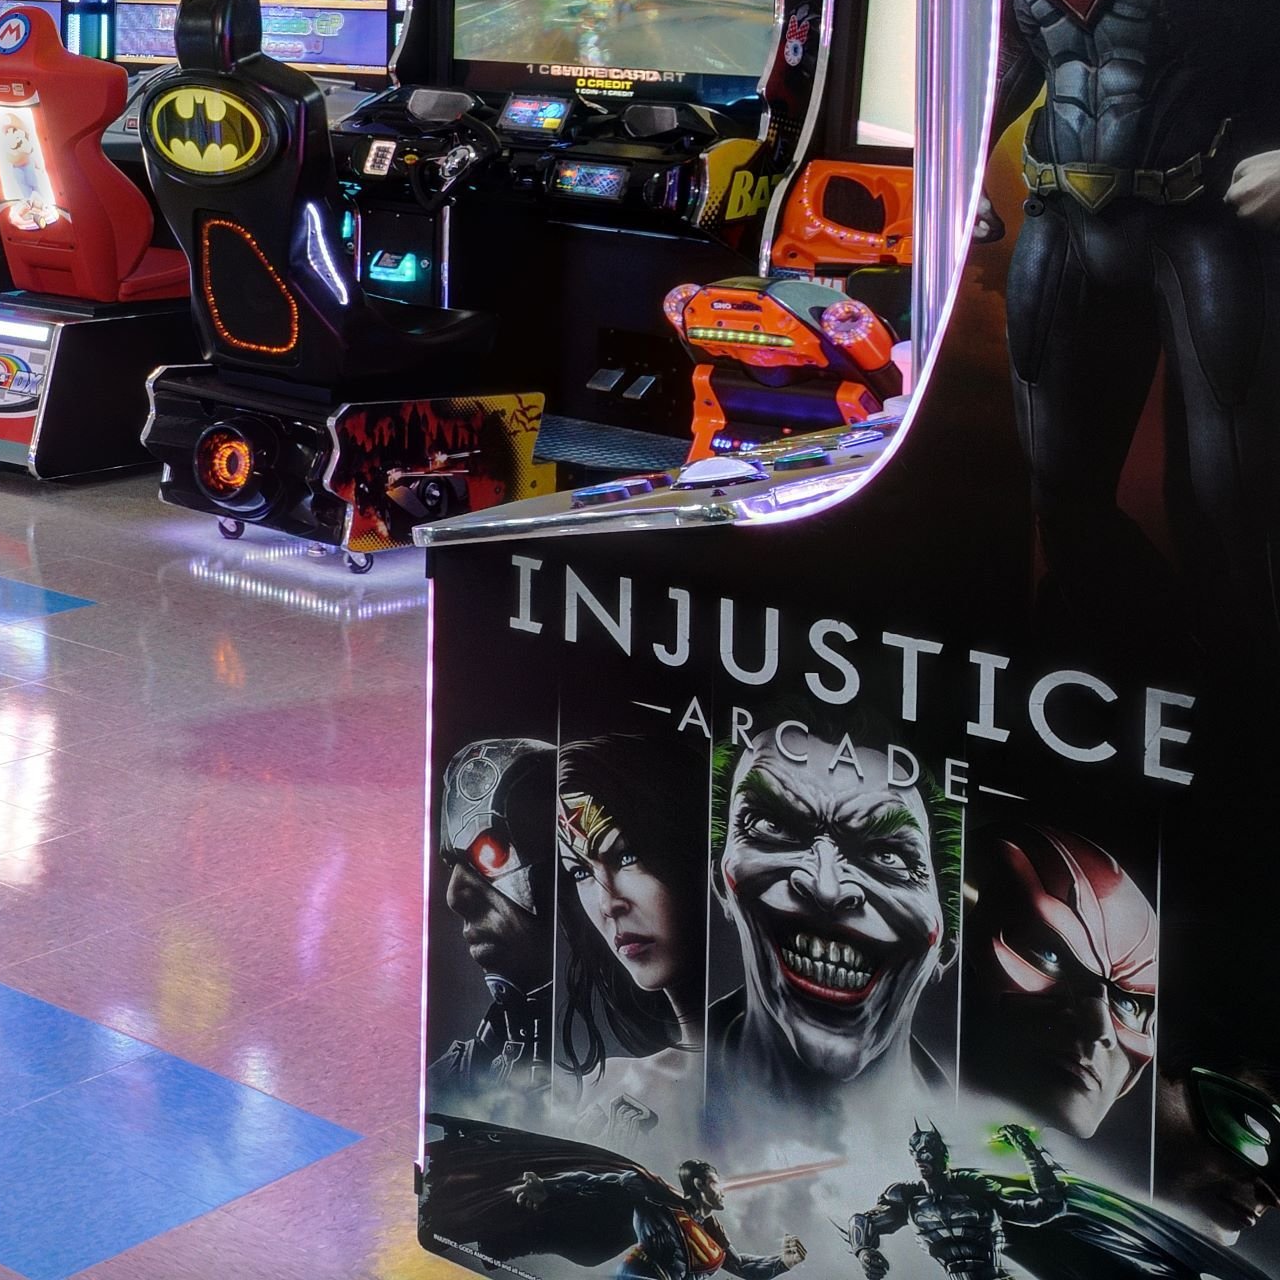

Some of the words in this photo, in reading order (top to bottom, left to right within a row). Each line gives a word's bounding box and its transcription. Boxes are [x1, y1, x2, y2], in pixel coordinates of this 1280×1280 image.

[587, 79, 633, 90] CREDIT
[9, 370, 44, 397] DX
[508, 554, 1197, 787] INJUSTICE
[677, 696, 971, 804] ARCADE
[458, 1244, 474, 1256] GODS
[474, 1250, 493, 1263] AMONG
